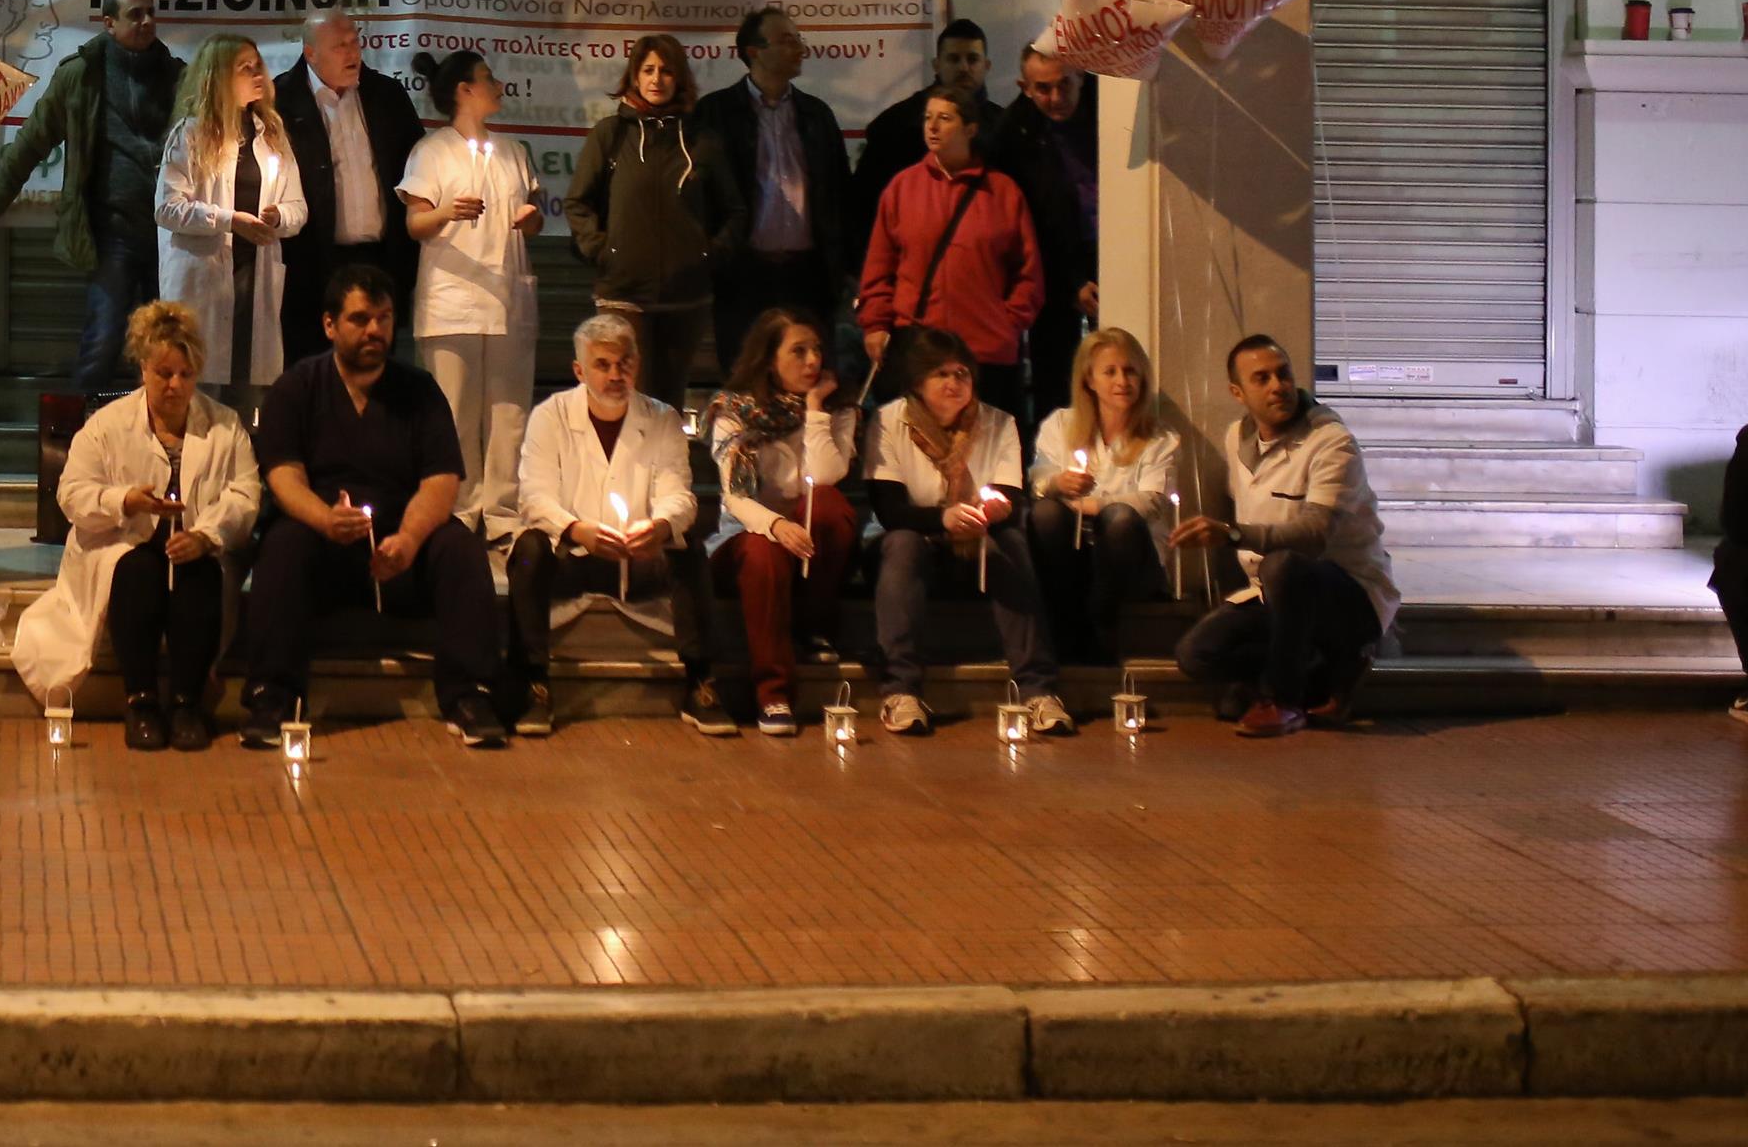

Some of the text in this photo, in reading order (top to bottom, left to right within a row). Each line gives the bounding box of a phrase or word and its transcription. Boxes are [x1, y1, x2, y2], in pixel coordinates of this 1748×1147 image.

[417, 33, 486, 56] στους
[492, 35, 582, 61] πολίτες
[587, 43, 616, 58] το
